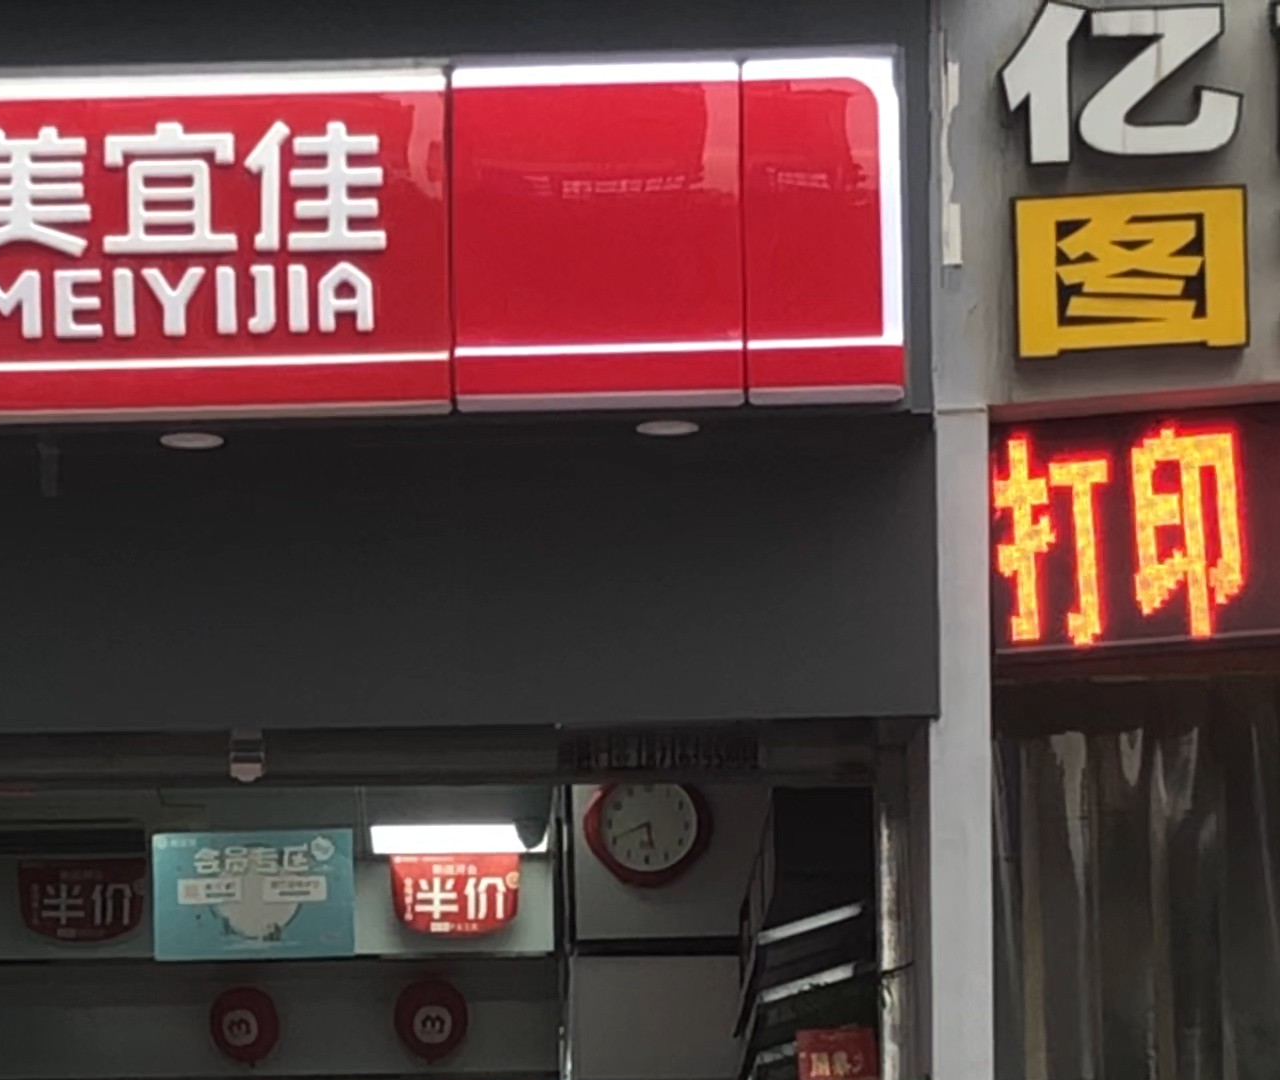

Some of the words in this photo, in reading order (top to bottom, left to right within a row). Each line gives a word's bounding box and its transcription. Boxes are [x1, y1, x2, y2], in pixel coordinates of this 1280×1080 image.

[993, 422, 1246, 647] 打印
[40, 882, 133, 928] 半价
[414, 875, 506, 920] 半价
